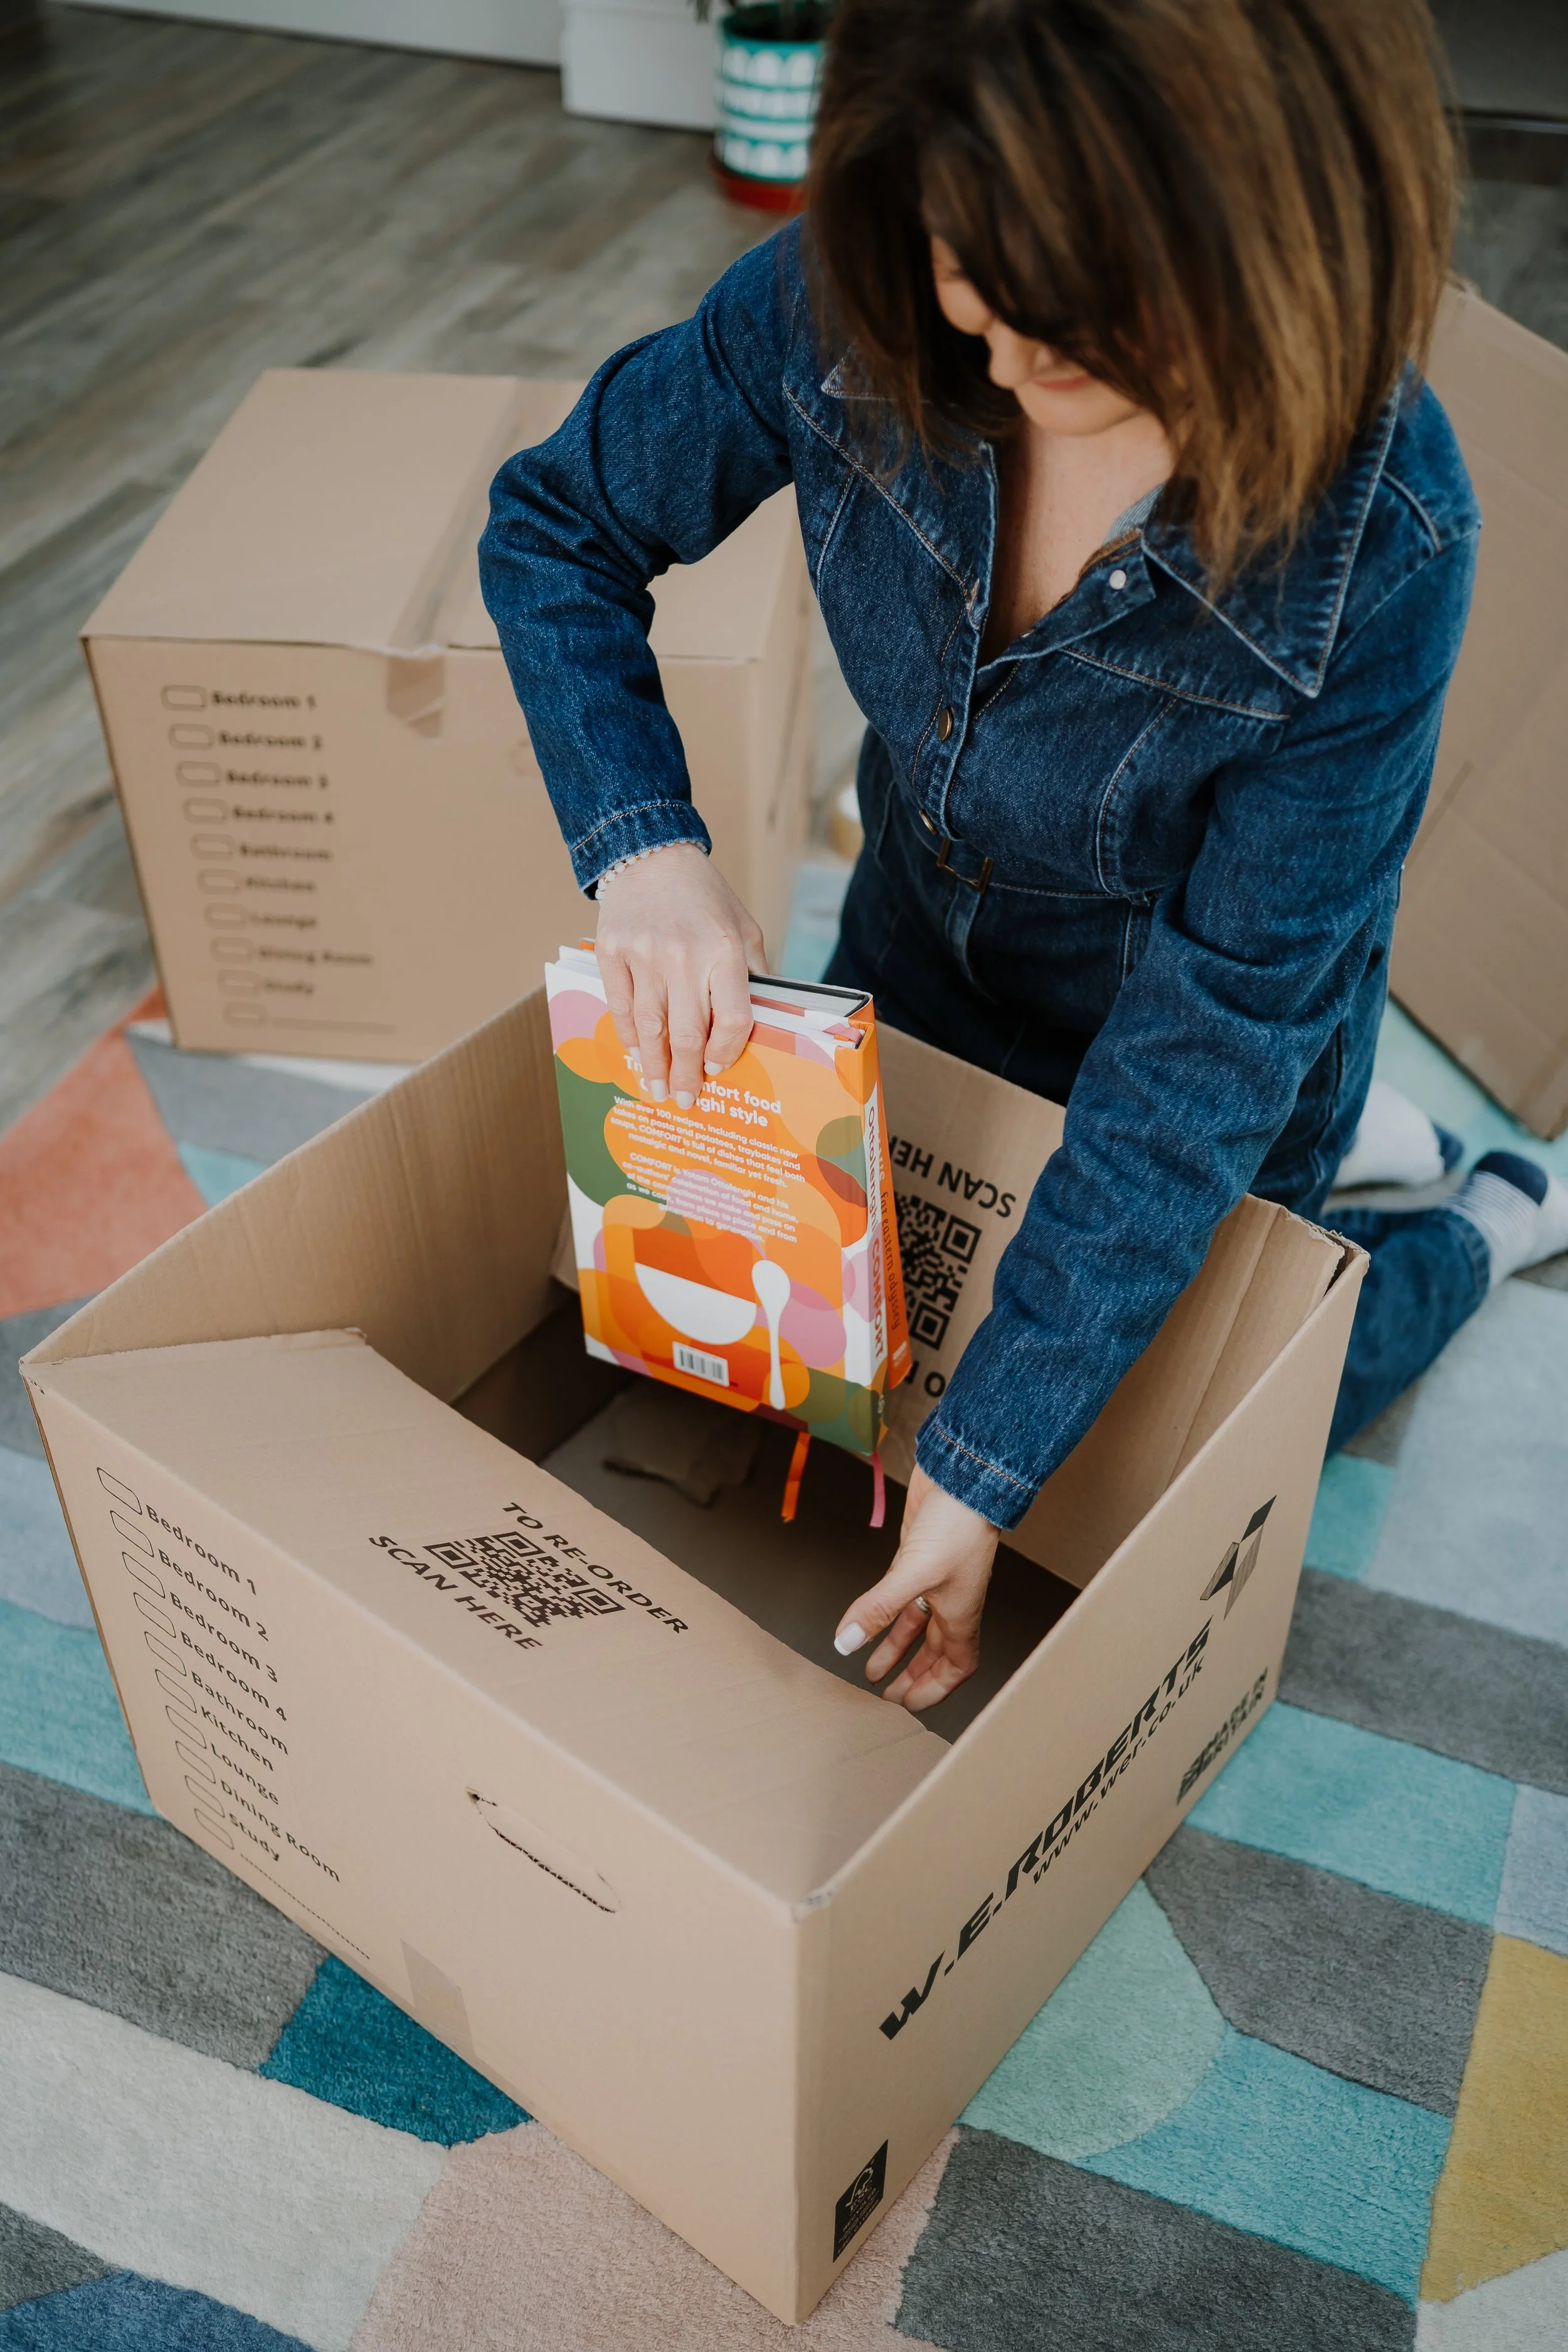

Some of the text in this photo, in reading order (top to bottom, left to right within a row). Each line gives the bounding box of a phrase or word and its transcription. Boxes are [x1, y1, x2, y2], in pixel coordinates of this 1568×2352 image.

[613, 1106, 800, 1171] takes on pasta and potatoes, traybakes and
[614, 1096, 798, 1159] With over 100 recipes, including classic new
[729, 1104, 769, 1127] style
[744, 1090, 781, 1115] food
[628, 1130, 787, 1188] nostalgic and novel, familiar yet fresh.
[638, 1123, 682, 1144] COMFORT
[682, 1137, 690, 1147] is
[691, 1139, 705, 1151] full
[706, 1144, 716, 1154] of
[717, 1147, 744, 1163] dishes
[746, 1157, 765, 1170] that
[766, 1163, 782, 1175] feel
[784, 1169, 805, 1183] both
[937, 1161, 1017, 1218] SCAN
[869, 1106, 883, 1359] Ottolenghi COMFORT
[882, 1220, 894, 1271] eastern
[888, 1273, 900, 1330] odyssey
[146, 1504, 256, 1596] Bedroom 1
[502, 1502, 689, 1634] TO RE-ORDER
[158, 1548, 268, 1642] Bedroom 2
[368, 1536, 543, 1650] SCAN HERE
[170, 1591, 278, 1683] Bedroom 3
[181, 1631, 287, 1722] Bedroom 4
[191, 1671, 289, 1755] Bathroom
[201, 1705, 273, 1772] Kitchen
[211, 1742, 279, 1805] Lounge
[1033, 1655, 1204, 1885] www.wer.co.uk
[221, 1779, 341, 1882] Dining Room
[229, 1813, 280, 1862] Study
